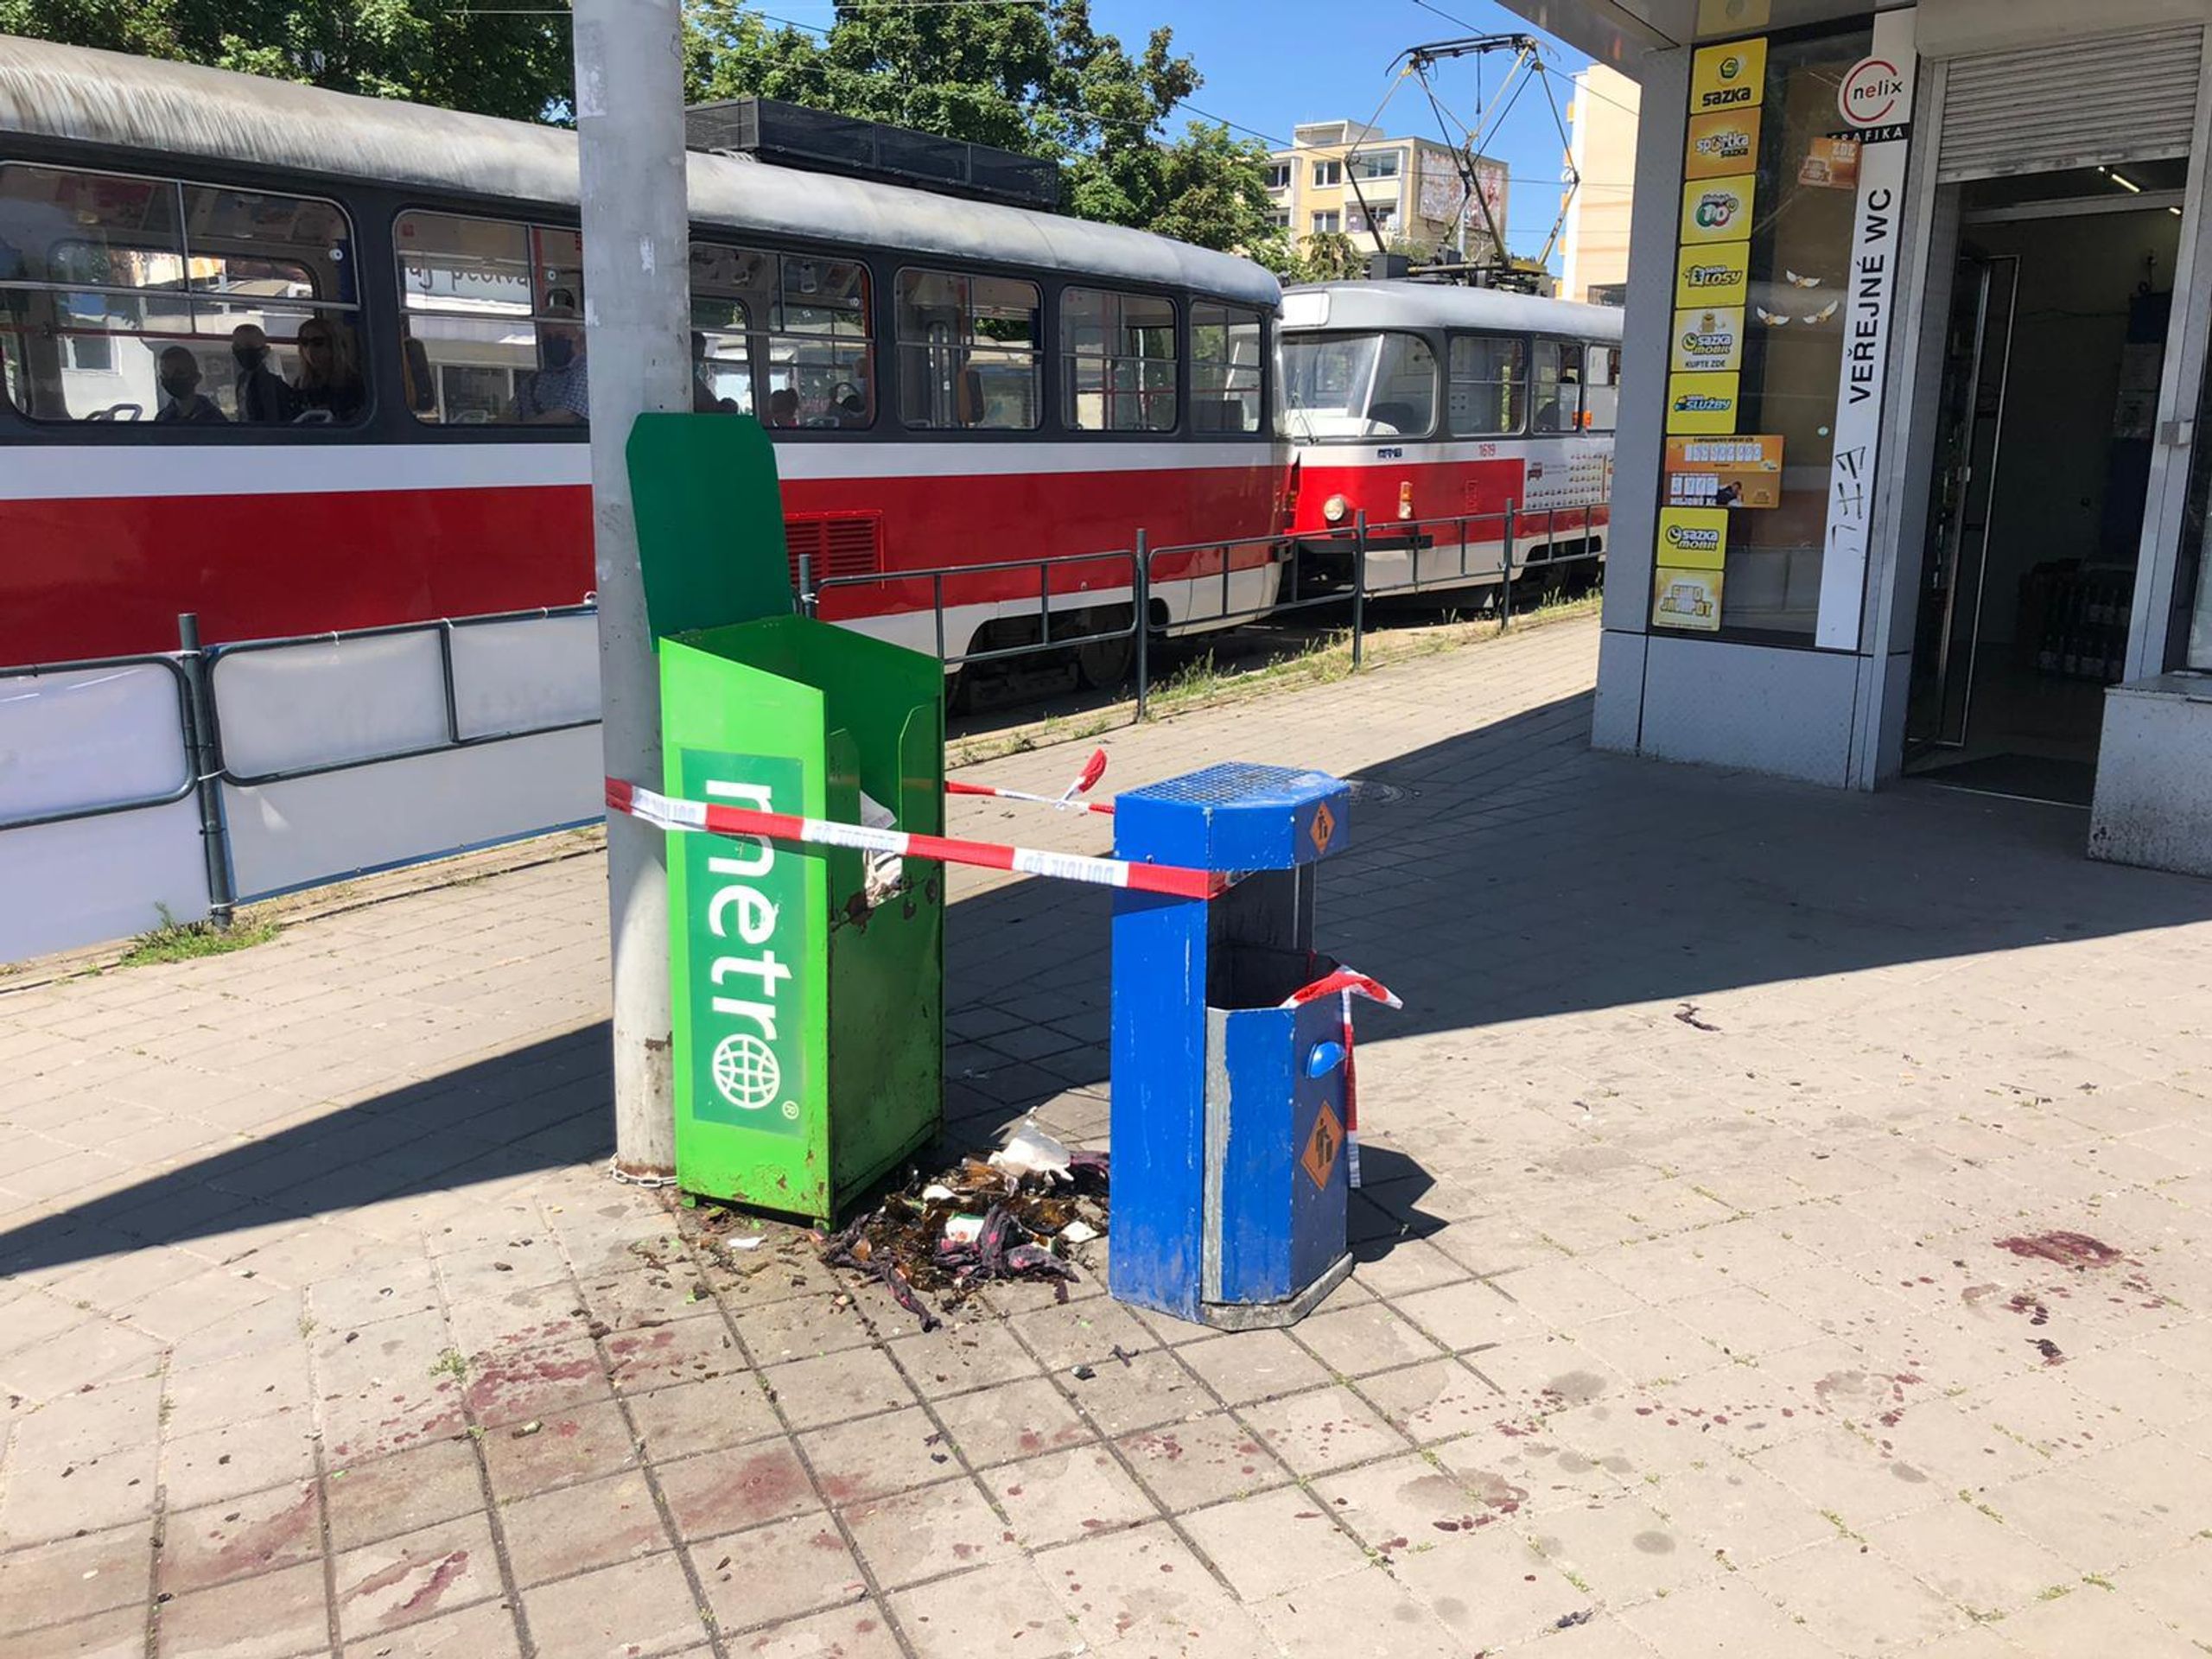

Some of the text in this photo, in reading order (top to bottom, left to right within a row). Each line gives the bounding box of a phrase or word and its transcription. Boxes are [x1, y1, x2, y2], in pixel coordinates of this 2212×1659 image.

[1853, 79, 1904, 100] nelix
[1847, 188, 1892, 404] VEŘEJNÉ WC
